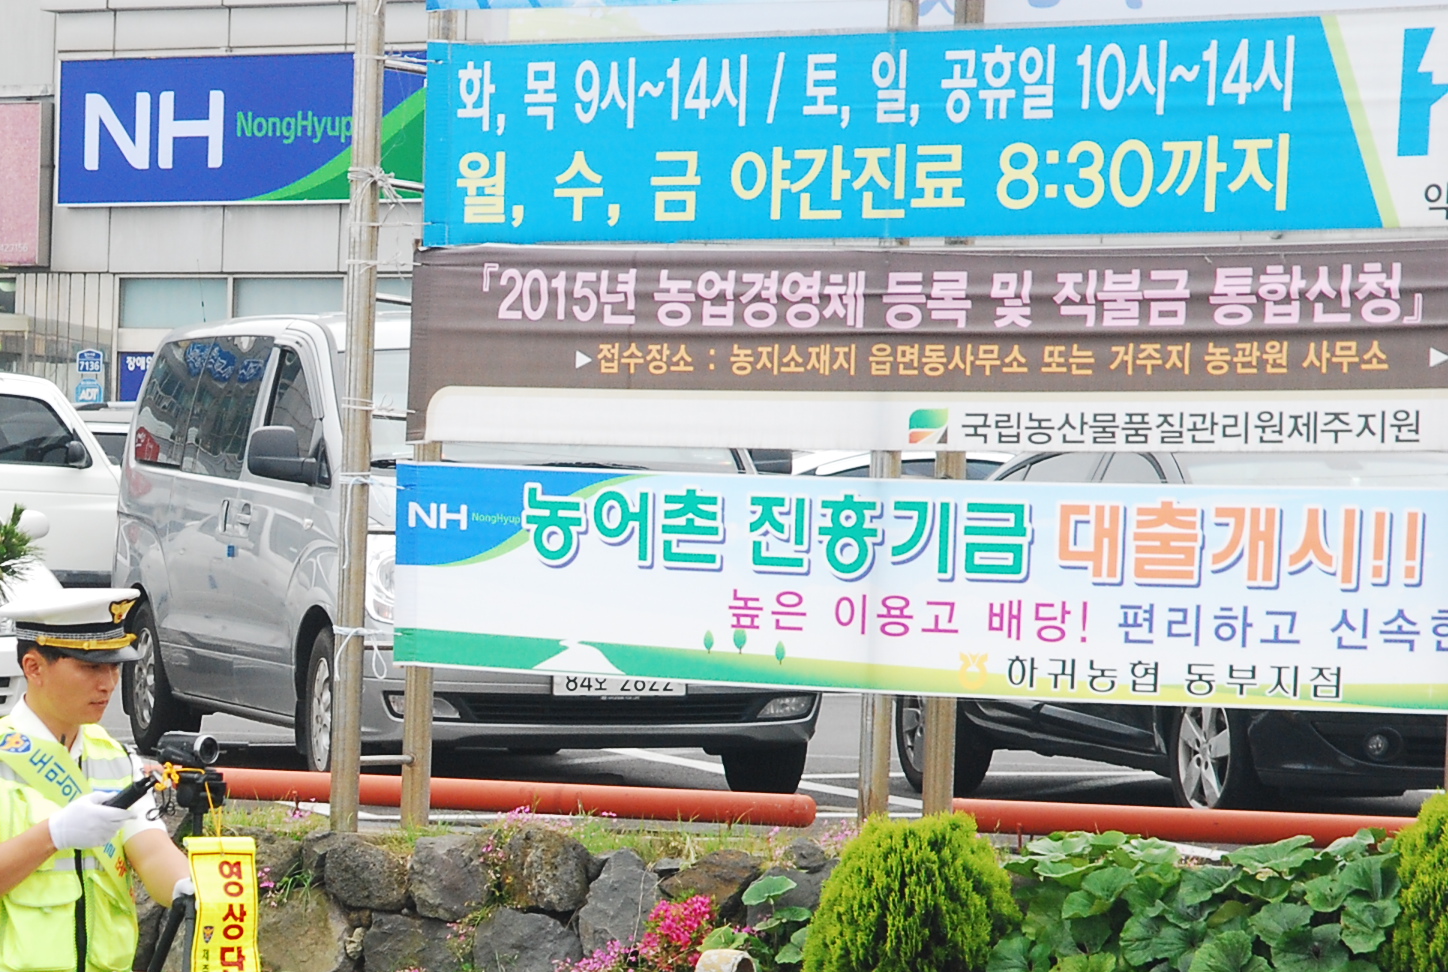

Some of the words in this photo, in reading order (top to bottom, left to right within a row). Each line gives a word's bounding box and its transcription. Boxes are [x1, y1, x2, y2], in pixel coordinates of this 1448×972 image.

[456, 60, 507, 135] 화,
[523, 61, 558, 130] 목
[575, 54, 748, 129] 9시~14시
[804, 53, 850, 129] 토,
[872, 49, 919, 128] 일,
[941, 44, 1056, 123] 공휴일
[1076, 35, 1296, 115] 10시~14시
[84, 90, 224, 170] NH
[236, 111, 353, 144] NongHyup
[456, 150, 525, 228] 월,
[553, 150, 620, 227] 수,
[650, 150, 701, 222] 금
[731, 144, 966, 220] 야간진료
[996, 132, 1290, 213] 8:30까지
[653, 269, 866, 329] 농업경영체
[882, 270, 972, 329] 등록
[990, 269, 1033, 328] 및
[1052, 268, 1191, 328] 직불금
[80, 361, 100, 371] 7136
[596, 342, 694, 375] 접수장소
[729, 343, 857, 375] 농지소재지
[868, 342, 1028, 376] 읍면동사무소
[1040, 343, 1096, 374] 또는
[1109, 342, 1192, 375] 거주지
[1204, 341, 1289, 373] 농관원
[1302, 340, 1389, 373] 사무소
[79, 388, 99, 400] ADT
[961, 410, 1421, 445] 국립농산물품질관리원제주지원
[408, 502, 468, 530] NH
[471, 512, 521, 525] NongHyup
[524, 483, 723, 568] 농어촌
[747, 490, 1033, 582] 진흥기금
[1056, 500, 1425, 591] 대출개시!!
[728, 588, 807, 632] 높은
[834, 594, 960, 637] 이용고
[988, 598, 1088, 644] 배당!
[1117, 602, 1301, 648] 편리하고
[1006, 654, 1160, 694] 하귀농협
[1184, 662, 1343, 701] 동부지점
